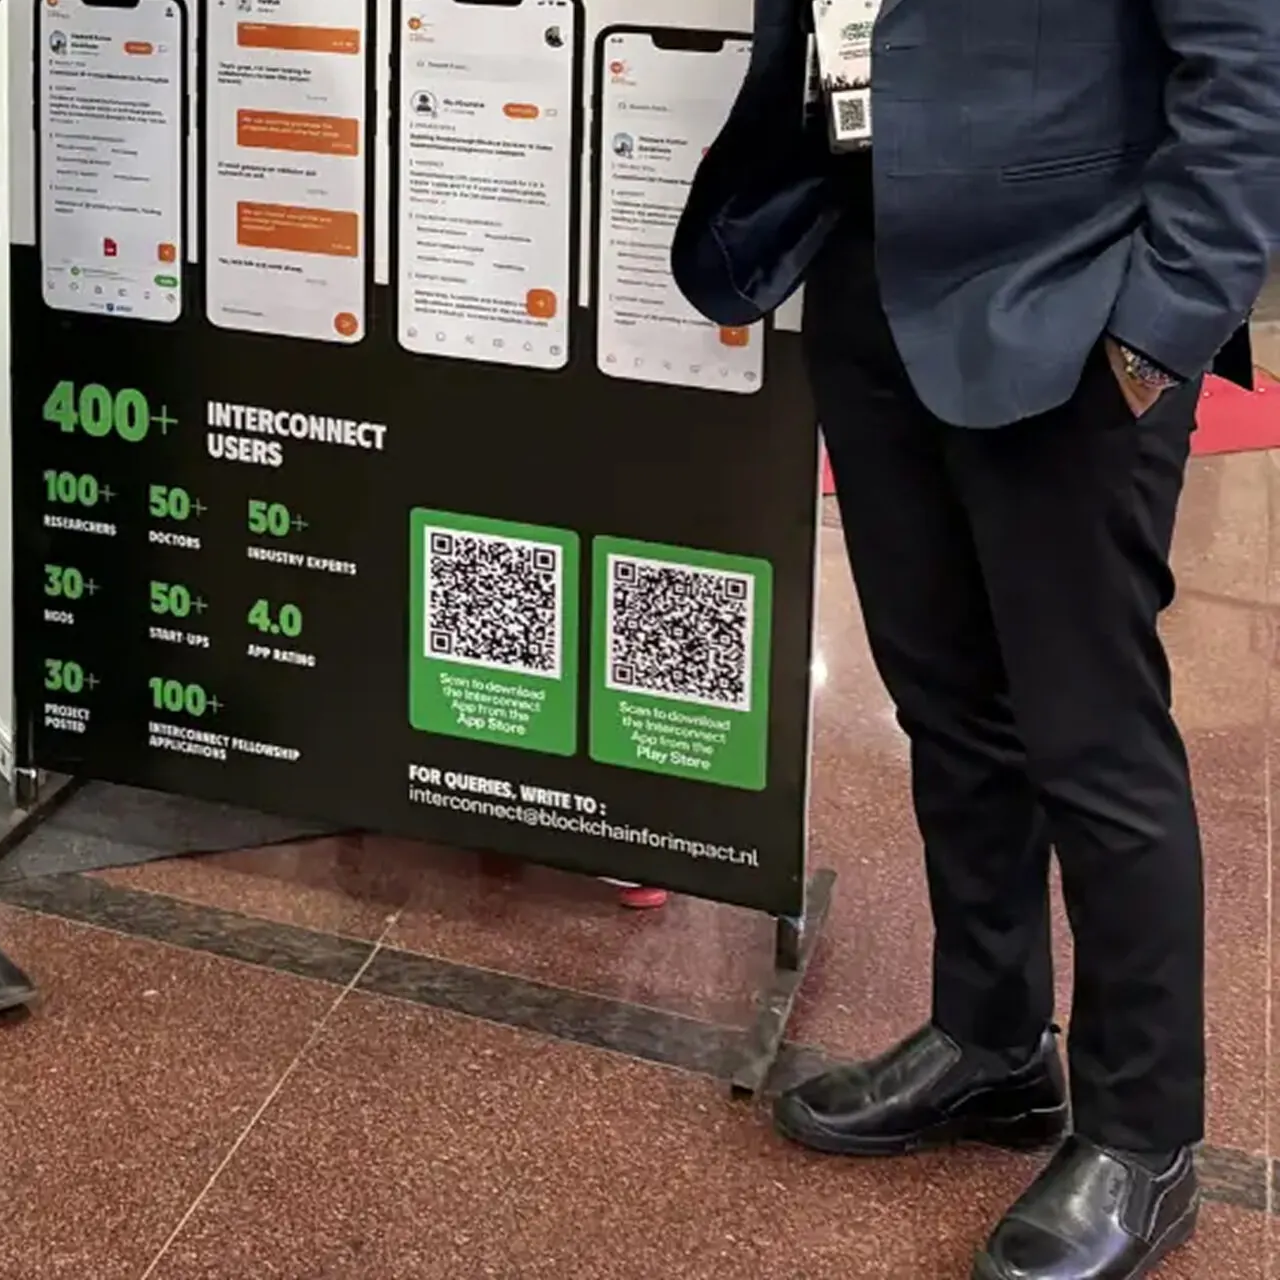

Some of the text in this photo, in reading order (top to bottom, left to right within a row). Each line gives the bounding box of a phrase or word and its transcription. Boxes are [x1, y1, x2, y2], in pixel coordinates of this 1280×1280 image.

[43, 379, 178, 443] 400+
[208, 401, 386, 453] INTERCONNECT
[208, 433, 282, 466] USERS
[43, 469, 117, 506] 100+
[148, 483, 207, 520] 50+
[247, 499, 309, 536] 50+
[149, 531, 200, 549] DOCTORS
[248, 547, 356, 575] INDUSTRY EXPERTS
[43, 563, 102, 600] 30+
[149, 580, 208, 618] 50+
[248, 600, 301, 636] 4.0
[248, 644, 315, 666] APP RATING
[43, 657, 101, 693] 30+
[440, 672, 470, 689] Scan
[471, 680, 485, 691] to
[148, 676, 223, 717] 100+
[442, 685, 463, 698] the
[45, 703, 90, 720] PROJECT
[45, 716, 85, 733] POSTED
[451, 699, 530, 722] App from the
[456, 712, 526, 736] App Store
[619, 701, 652, 717] Scan
[653, 707, 667, 720] to
[622, 716, 644, 729] the
[148, 721, 300, 760] INTERCONNECT FELLOWSHIP
[148, 734, 227, 760] APPLICATIONS
[630, 730, 658, 746] App
[691, 741, 715, 756] the
[636, 744, 712, 771] Play Store
[409, 765, 441, 785] FOR
[444, 771, 517, 801] QUERIES,
[520, 785, 571, 811] WRITE
[574, 795, 596, 813] TO
[409, 784, 759, 868] interconnect@blockchainforimpact.nl
